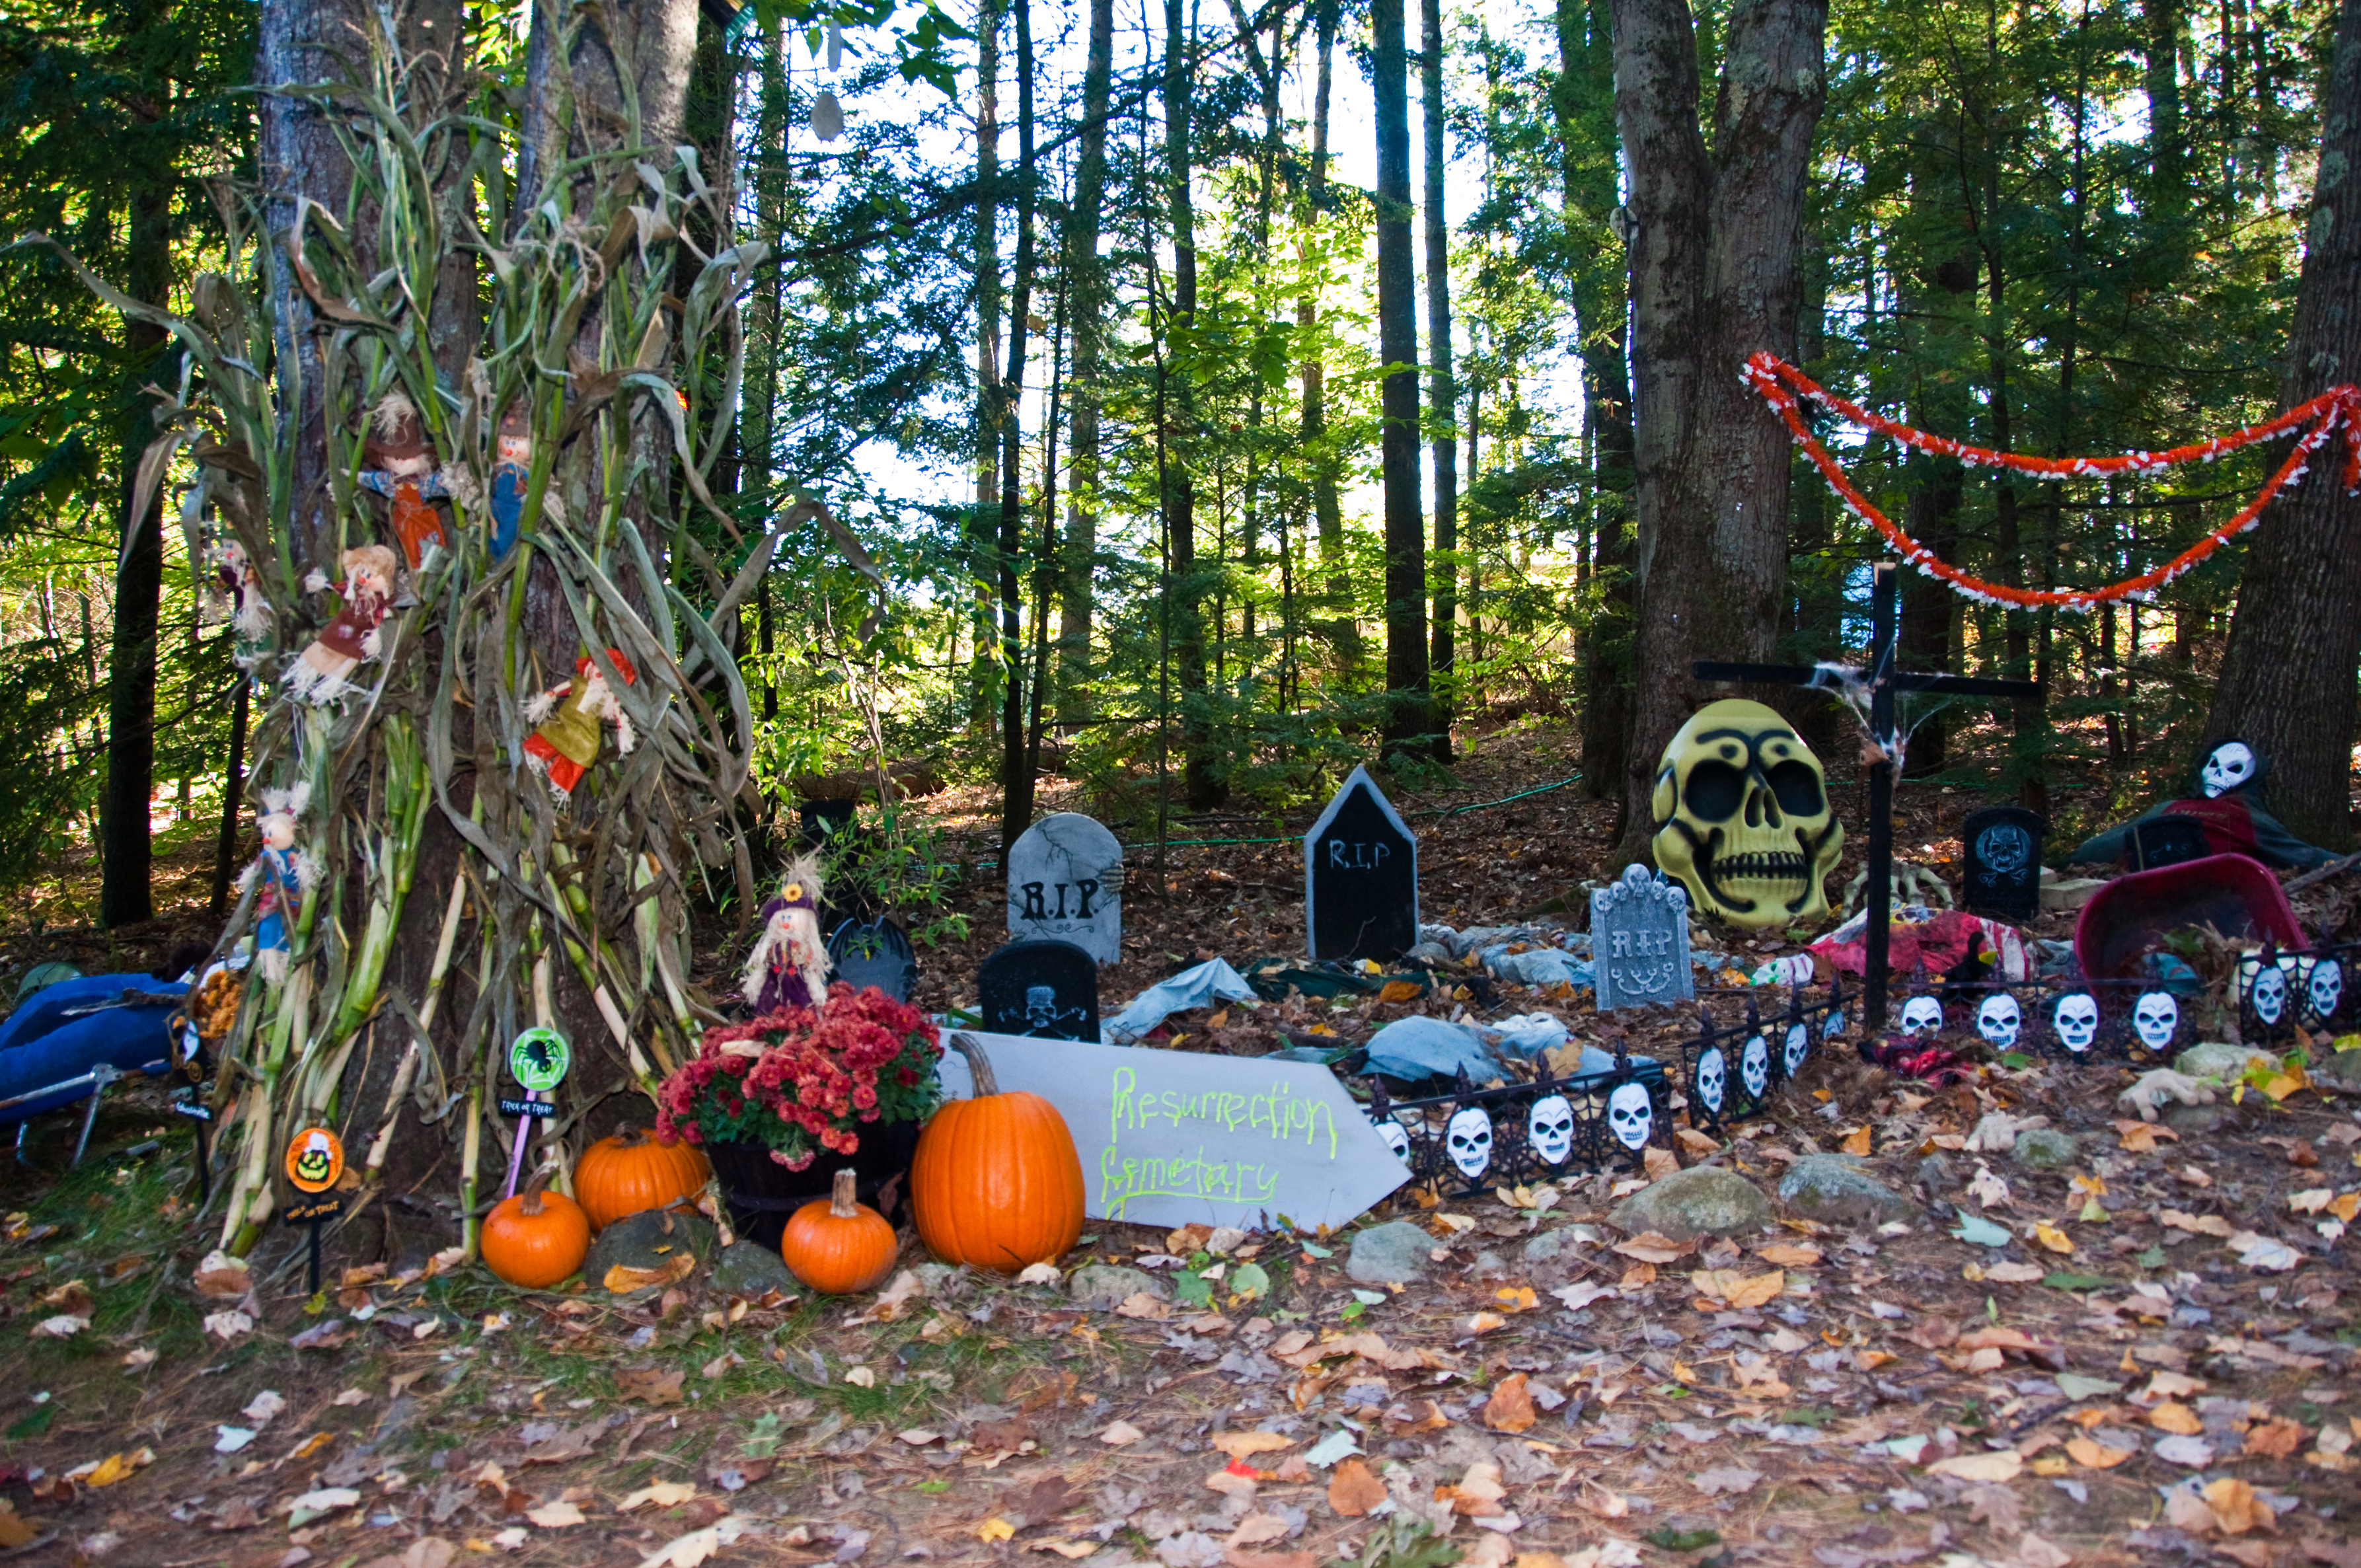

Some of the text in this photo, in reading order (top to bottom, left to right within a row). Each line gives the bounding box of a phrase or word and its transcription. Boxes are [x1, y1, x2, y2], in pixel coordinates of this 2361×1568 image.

[1020, 878, 1100, 920] R.I.P.
[1612, 929, 1672, 958] RIP
[502, 1100, 554, 1115] TRICK OR TREAT
[1112, 1066, 1337, 1159] Resurrection
[1101, 1145, 1280, 1205] Cemetary
[304, 1209, 315, 1218] OR
[315, 1200, 339, 1215] TREAT
